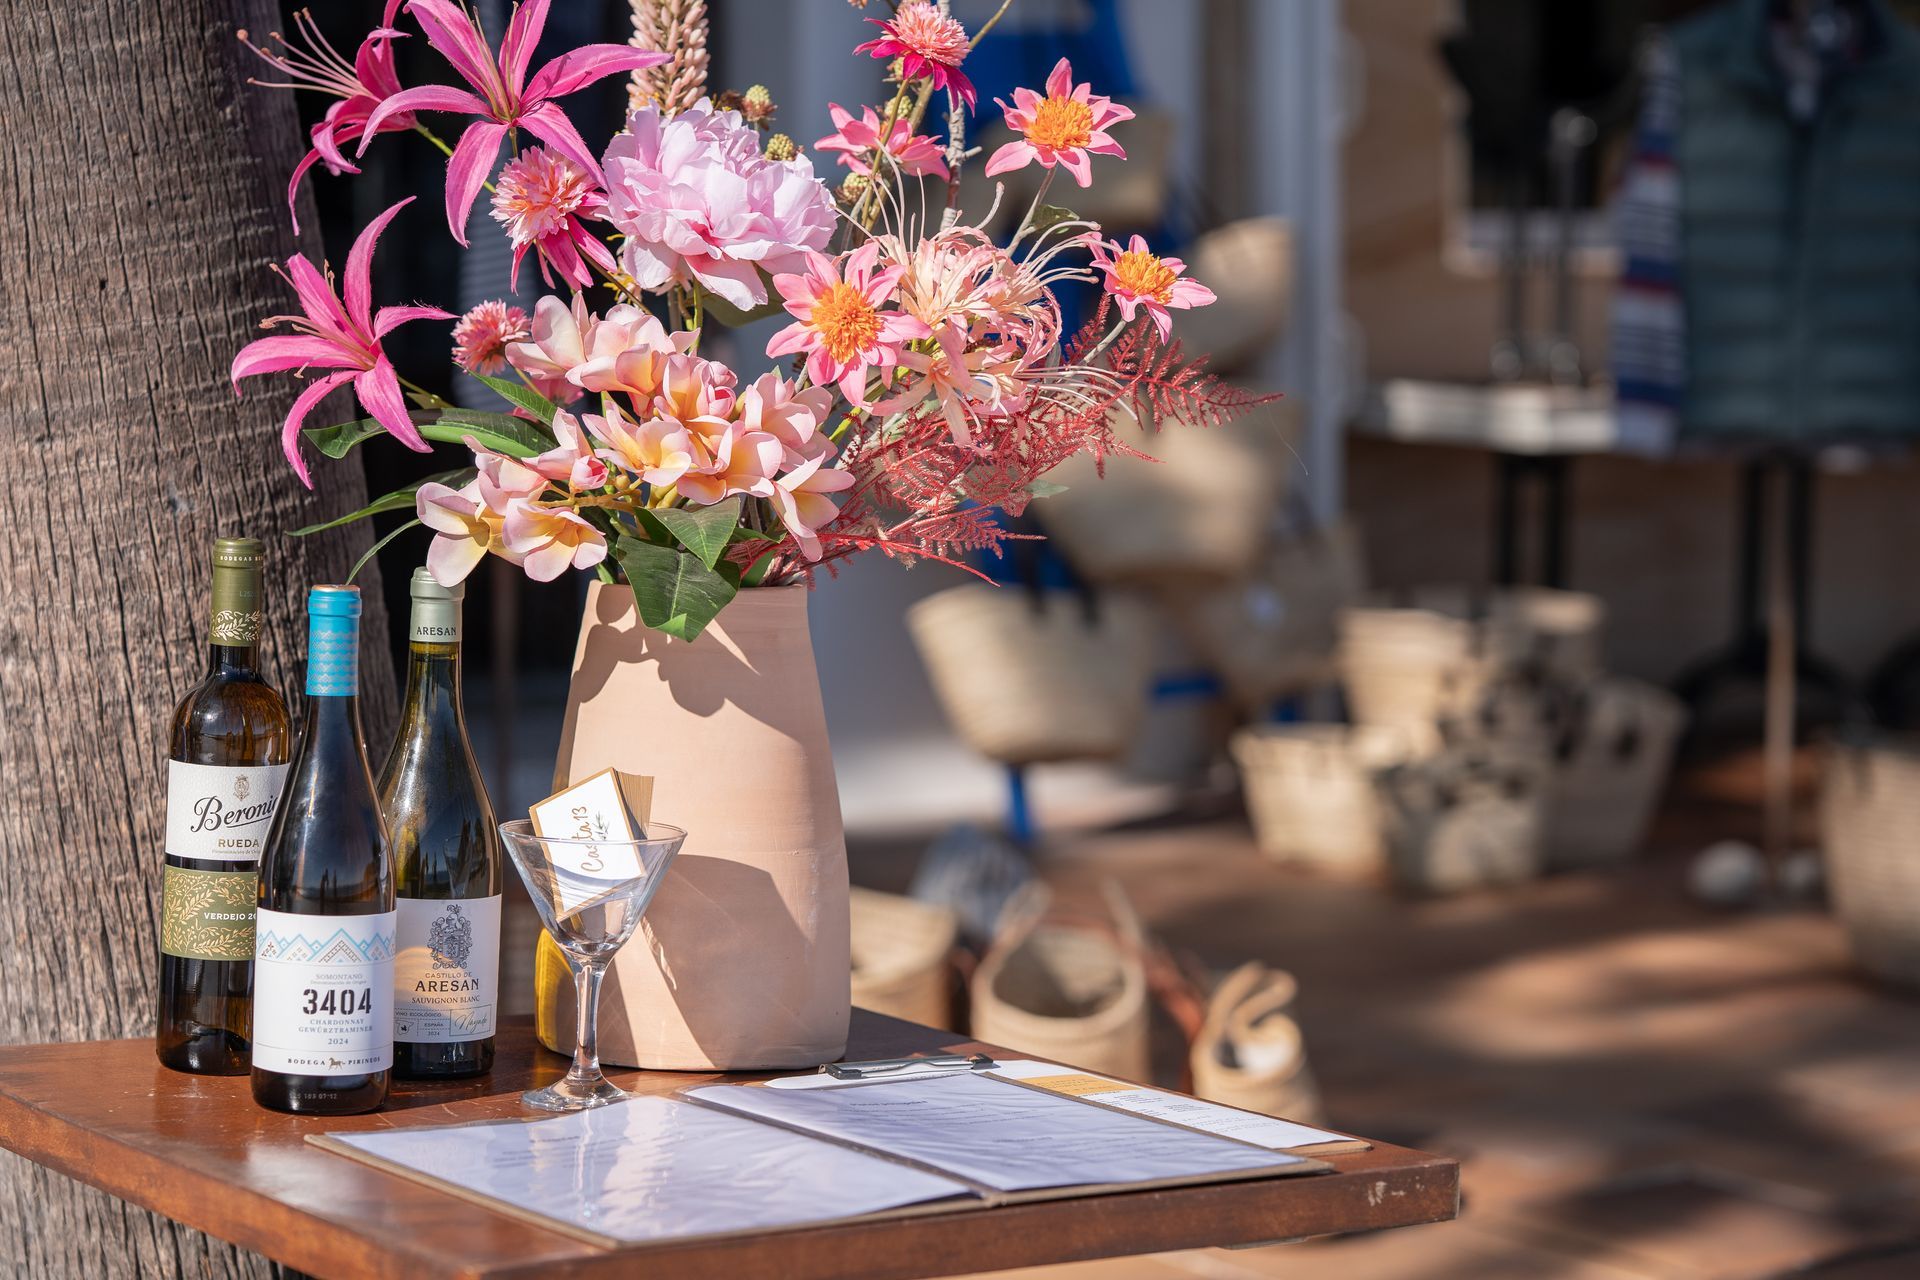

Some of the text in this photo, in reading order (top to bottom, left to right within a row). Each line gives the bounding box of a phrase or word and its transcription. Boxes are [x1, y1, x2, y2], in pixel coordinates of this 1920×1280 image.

[416, 626, 457, 636] ARESAN
[571, 806, 588, 821] 13
[218, 839, 260, 848] RUEDA
[203, 912, 246, 921] VERDEJO
[415, 978, 479, 992] ARESAN
[303, 987, 372, 1015] 3404
[460, 995, 480, 1003] BLANC
[348, 1056, 380, 1065] PIRINEOS
